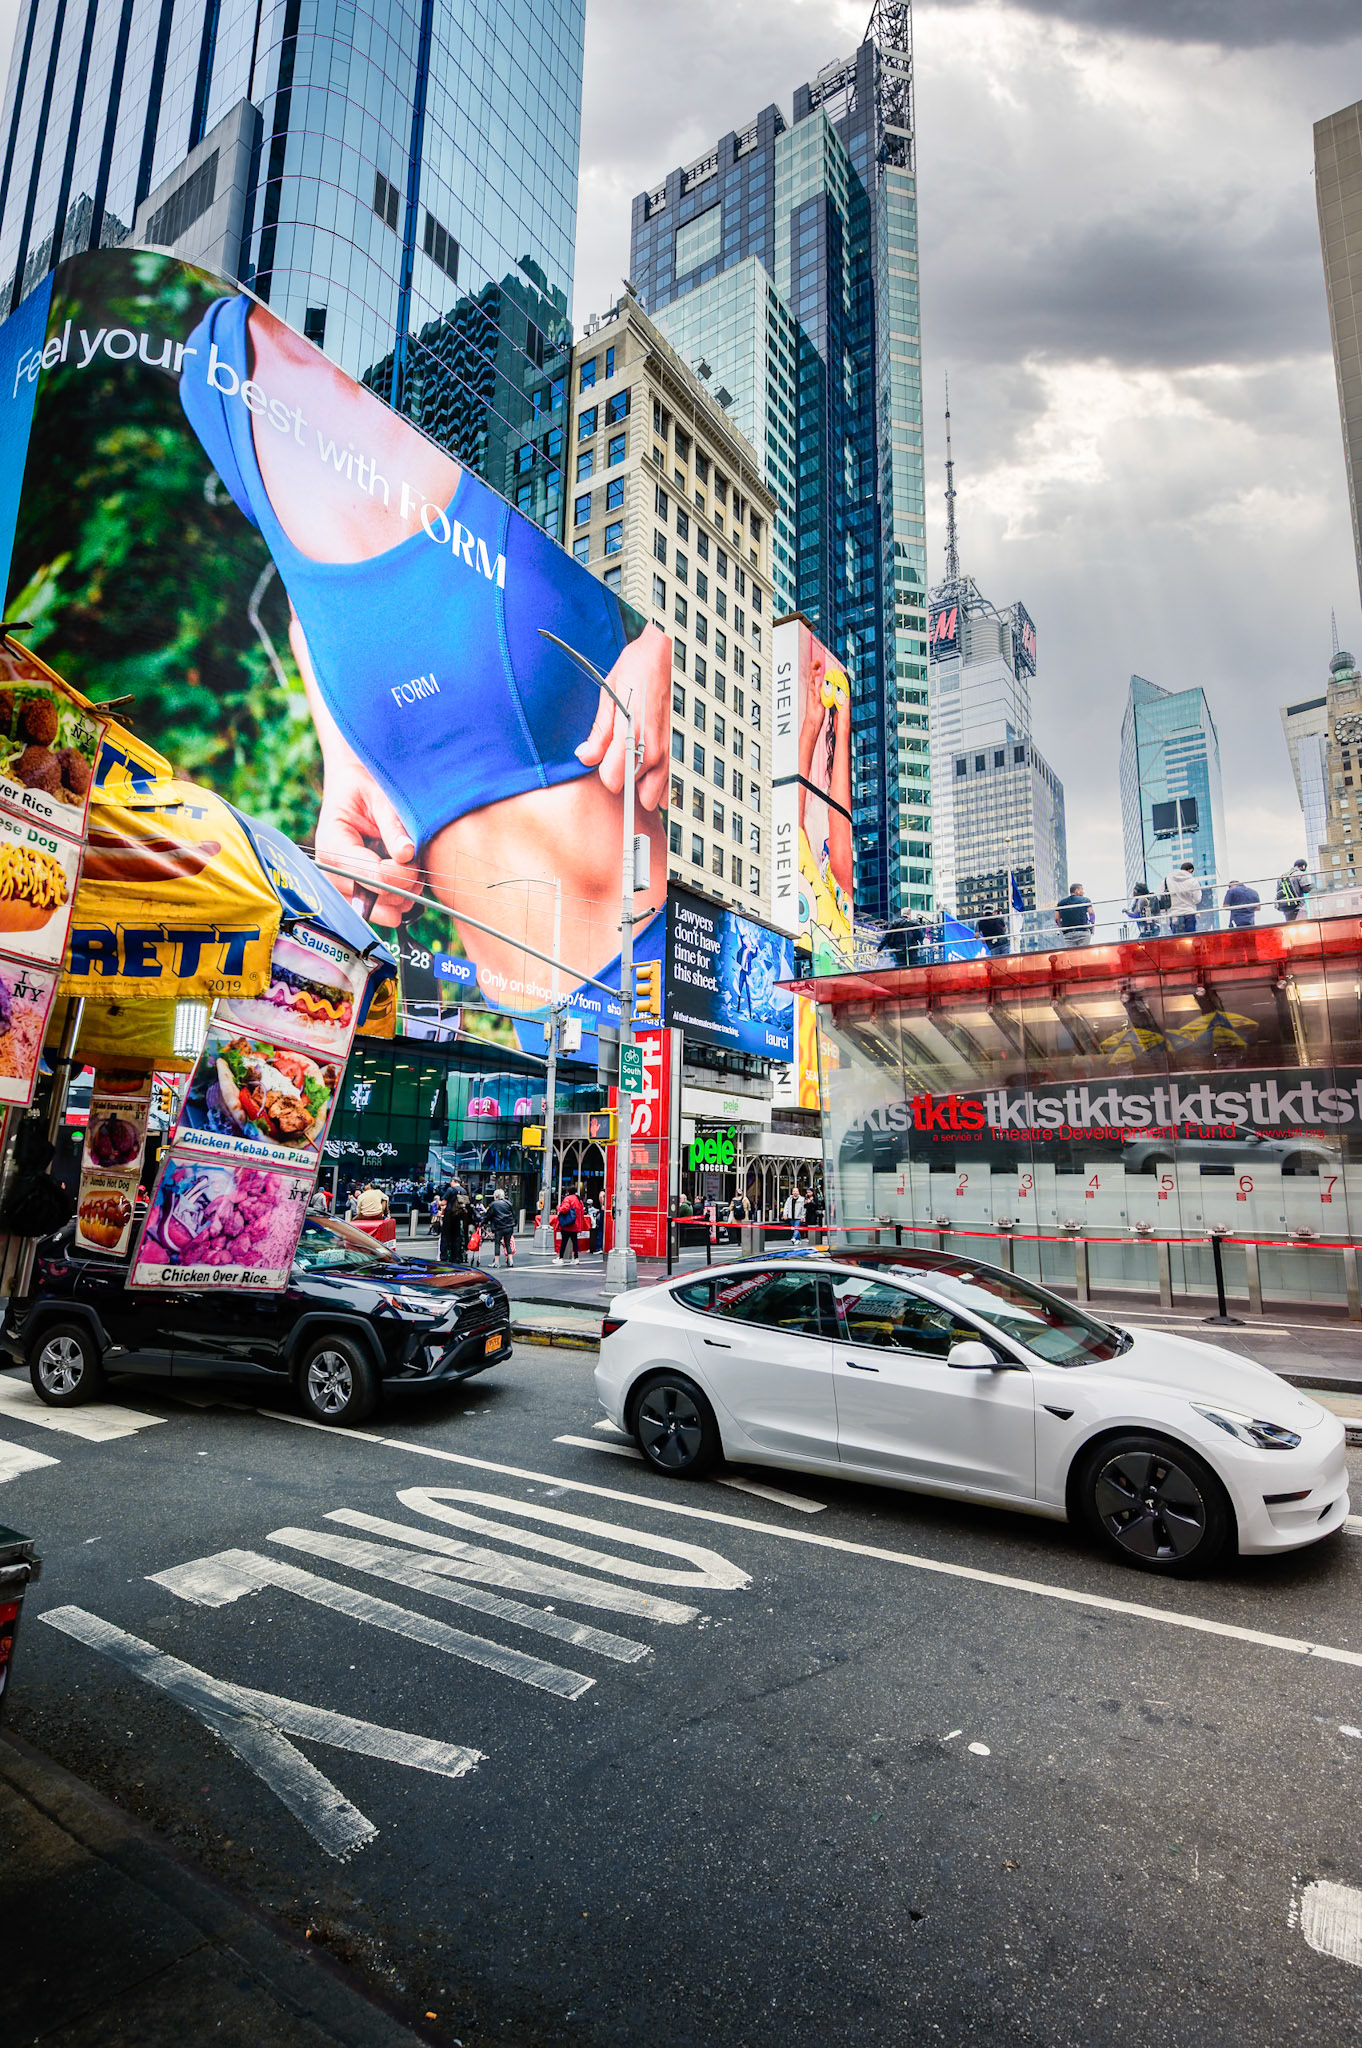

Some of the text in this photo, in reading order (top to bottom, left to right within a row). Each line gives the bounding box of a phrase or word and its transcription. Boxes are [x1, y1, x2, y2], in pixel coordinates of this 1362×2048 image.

[13, 319, 507, 590] Feel your best with FORM
[391, 673, 440, 708] FORM
[777, 662, 791, 736] SHEIN
[70, 724, 94, 748] NY
[22, 792, 53, 817] Rice
[27, 828, 58, 853] Dog
[776, 822, 791, 898] SHEIN
[675, 902, 714, 932] Lawyers
[301, 931, 350, 962] Sausage
[674, 923, 721, 954] don't have
[674, 943, 711, 970] time for
[18, 970, 29, 985] I
[441, 960, 471, 980] shop
[480, 968, 507, 991] Only
[514, 977, 524, 993] on
[673, 963, 719, 993] this sheet.
[12, 984, 45, 1002] NY
[207, 979, 241, 992] 2019
[607, 1003, 622, 1016] sho
[679, 1012, 689, 1024] that
[689, 1016, 712, 1029] automates
[711, 1021, 721, 1032] time
[765, 1030, 789, 1049] laurel
[622, 1065, 642, 1076] South
[933, 1121, 1326, 1145] a service of Theatre Development Fund www.tdf.org
[183, 1131, 231, 1150] Chicken
[234, 1140, 269, 1157] Kebab
[272, 1150, 286, 1160] on
[288, 1151, 310, 1165] Pita
[689, 1126, 736, 1172] pelé
[700, 1163, 729, 1172] SOCCER
[107, 1178, 117, 1188] Hot
[119, 1179, 130, 1191] Dog
[293, 1179, 300, 1189] I
[899, 1173, 1338, 1193] 1 2 3 4 5 6 7
[288, 1190, 308, 1201] NY
[161, 1268, 268, 1284] Chicken Over Rice
[37, 1485, 756, 1864] ONLY
